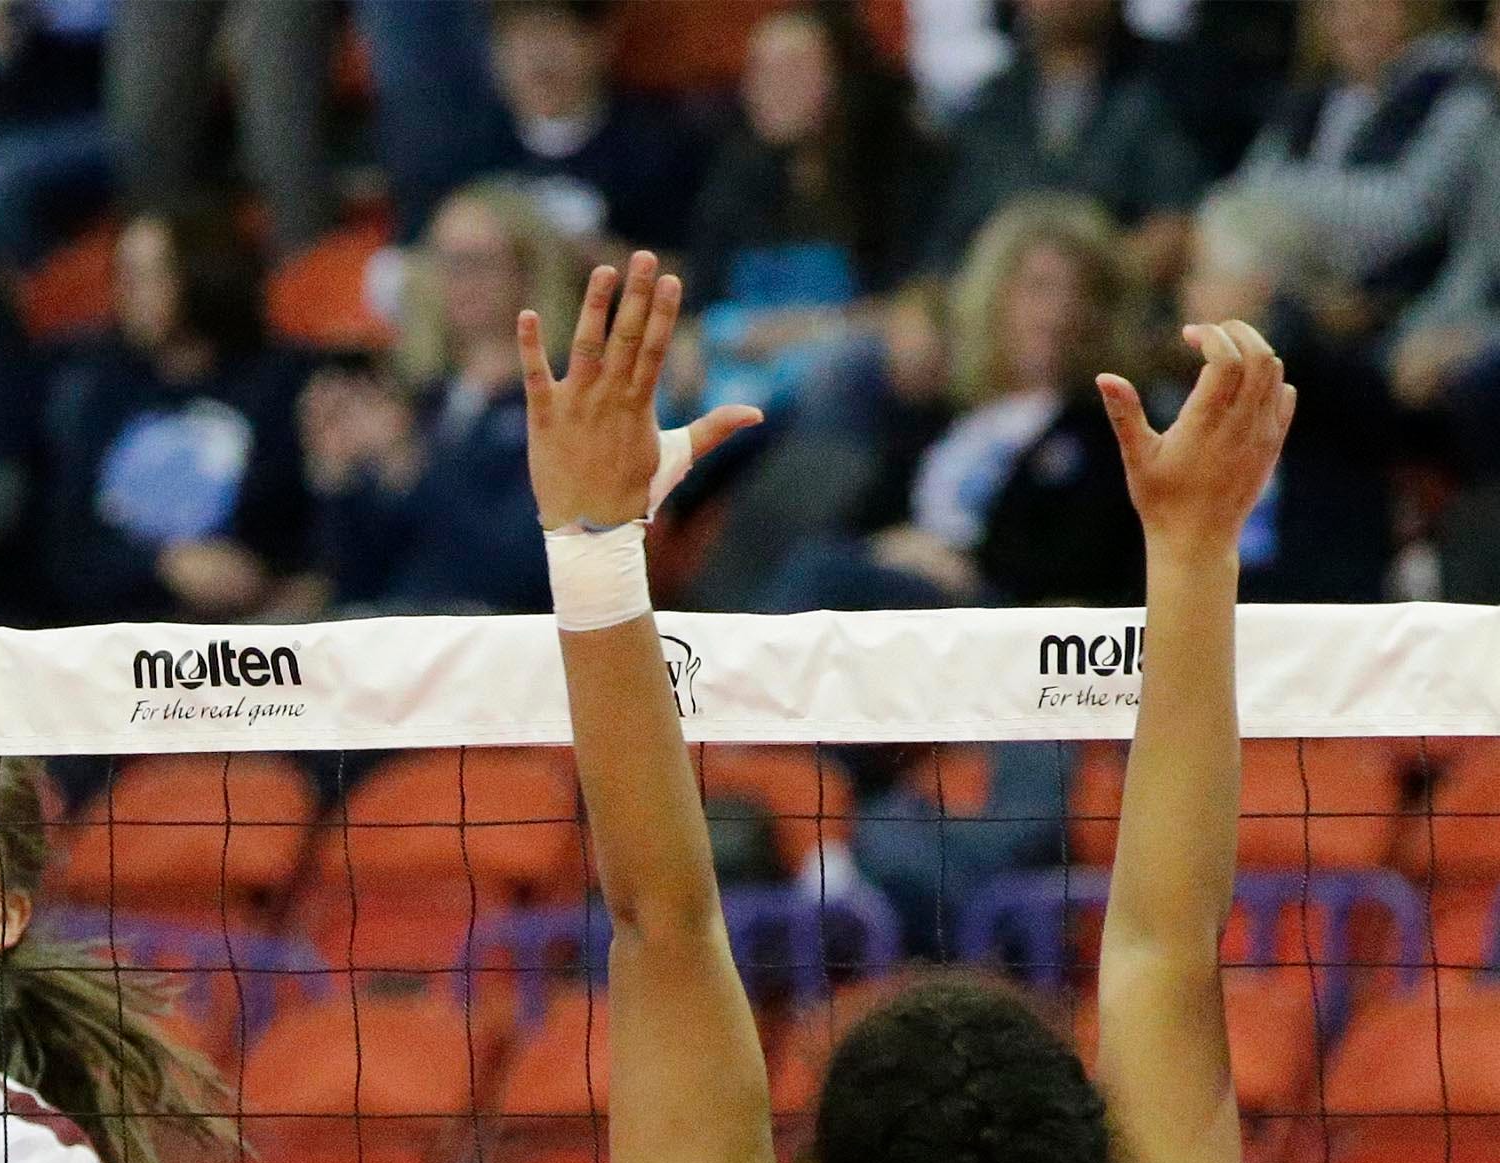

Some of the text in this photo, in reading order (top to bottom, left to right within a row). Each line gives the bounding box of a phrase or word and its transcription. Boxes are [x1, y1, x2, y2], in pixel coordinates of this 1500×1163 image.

[133, 640, 302, 690] molten
[130, 696, 309, 726] For the real game
[1038, 686, 1072, 709] For
[1077, 685, 1111, 706] the
